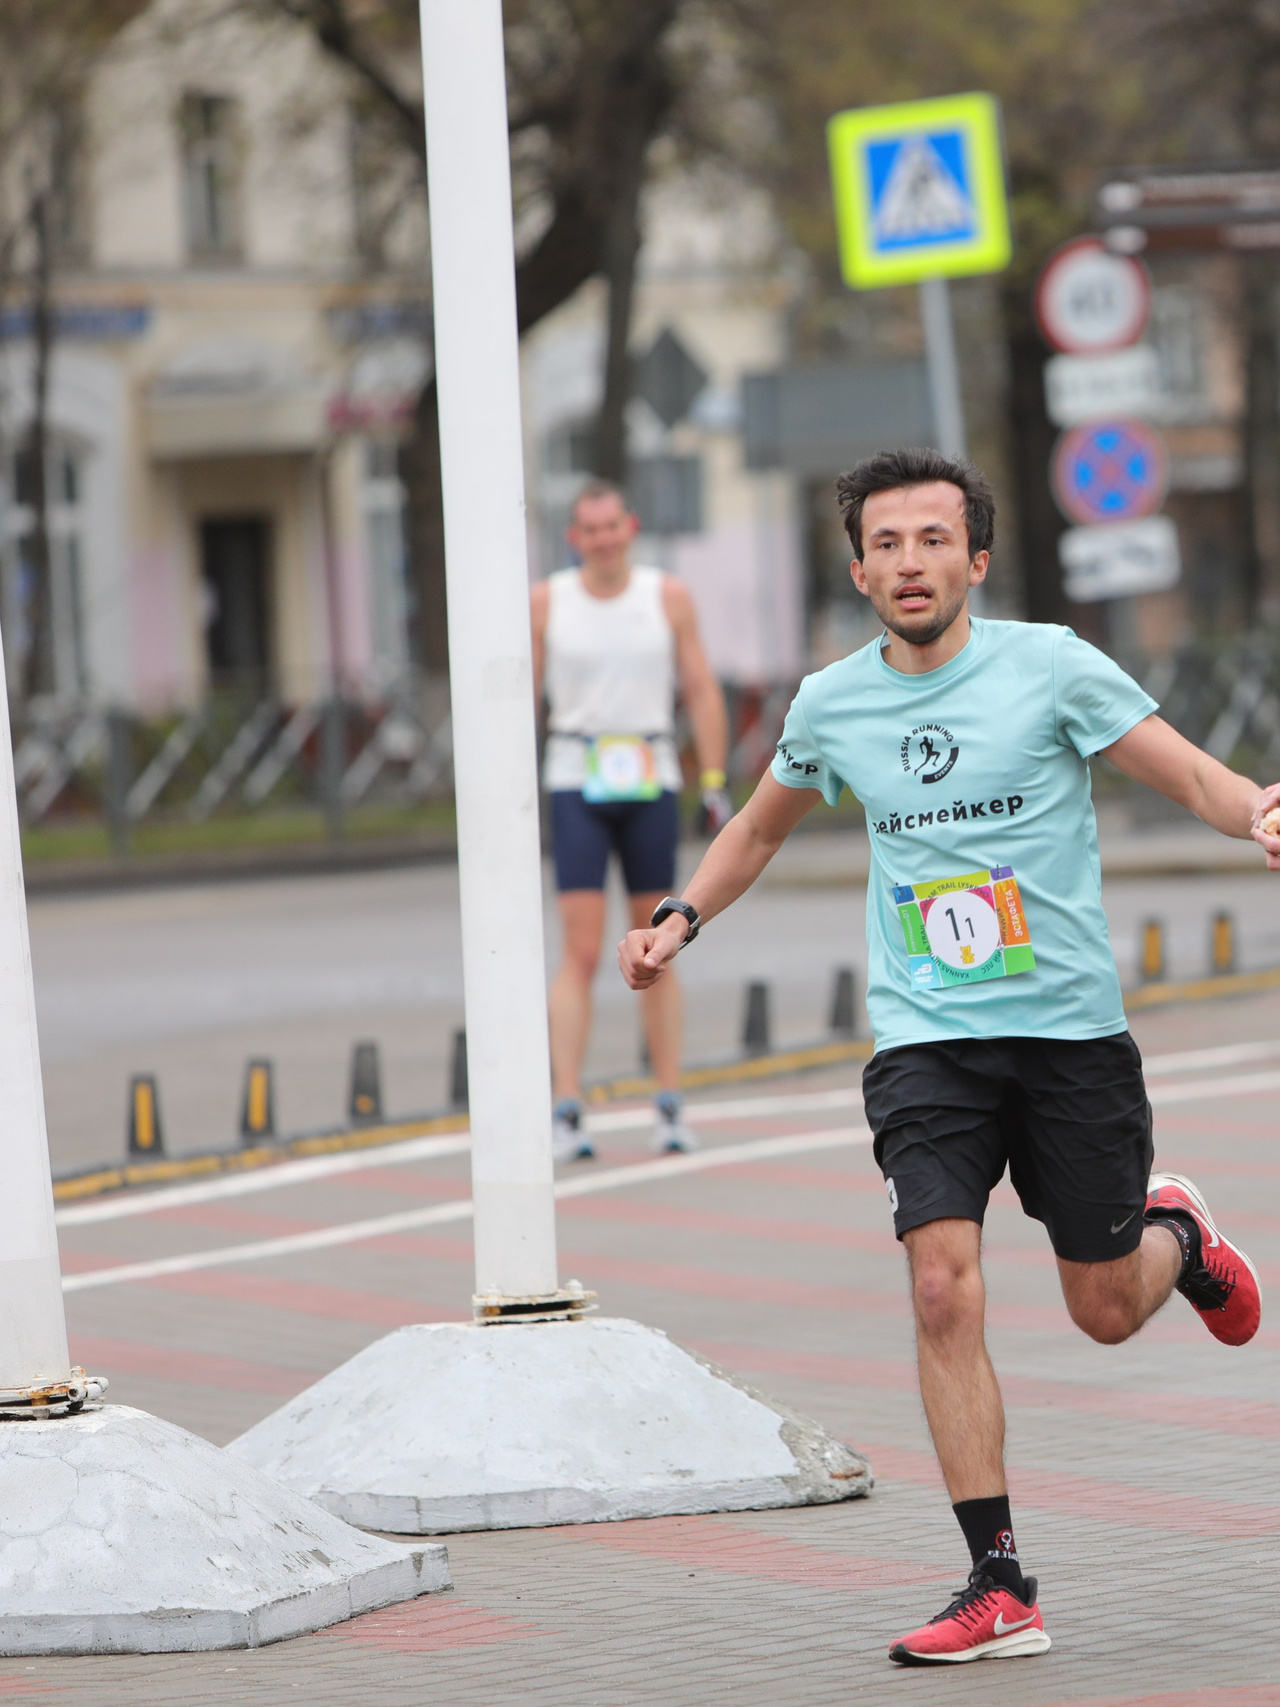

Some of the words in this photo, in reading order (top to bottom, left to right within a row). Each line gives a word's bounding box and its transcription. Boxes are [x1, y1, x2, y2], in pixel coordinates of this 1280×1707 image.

[901, 735, 911, 772] RUSSIA
[912, 724, 954, 742] RUNNING
[934, 760, 954, 780] EVENTS
[937, 881, 957, 892] TRAIL
[1005, 889, 1023, 937] ЭСТАФЕТА
[945, 907, 960, 941] 1
[965, 917, 975, 938] 1
[920, 924, 928, 945] TRAIL
[941, 964, 969, 979] KANNAS
[981, 962, 994, 974] ЛЕС
